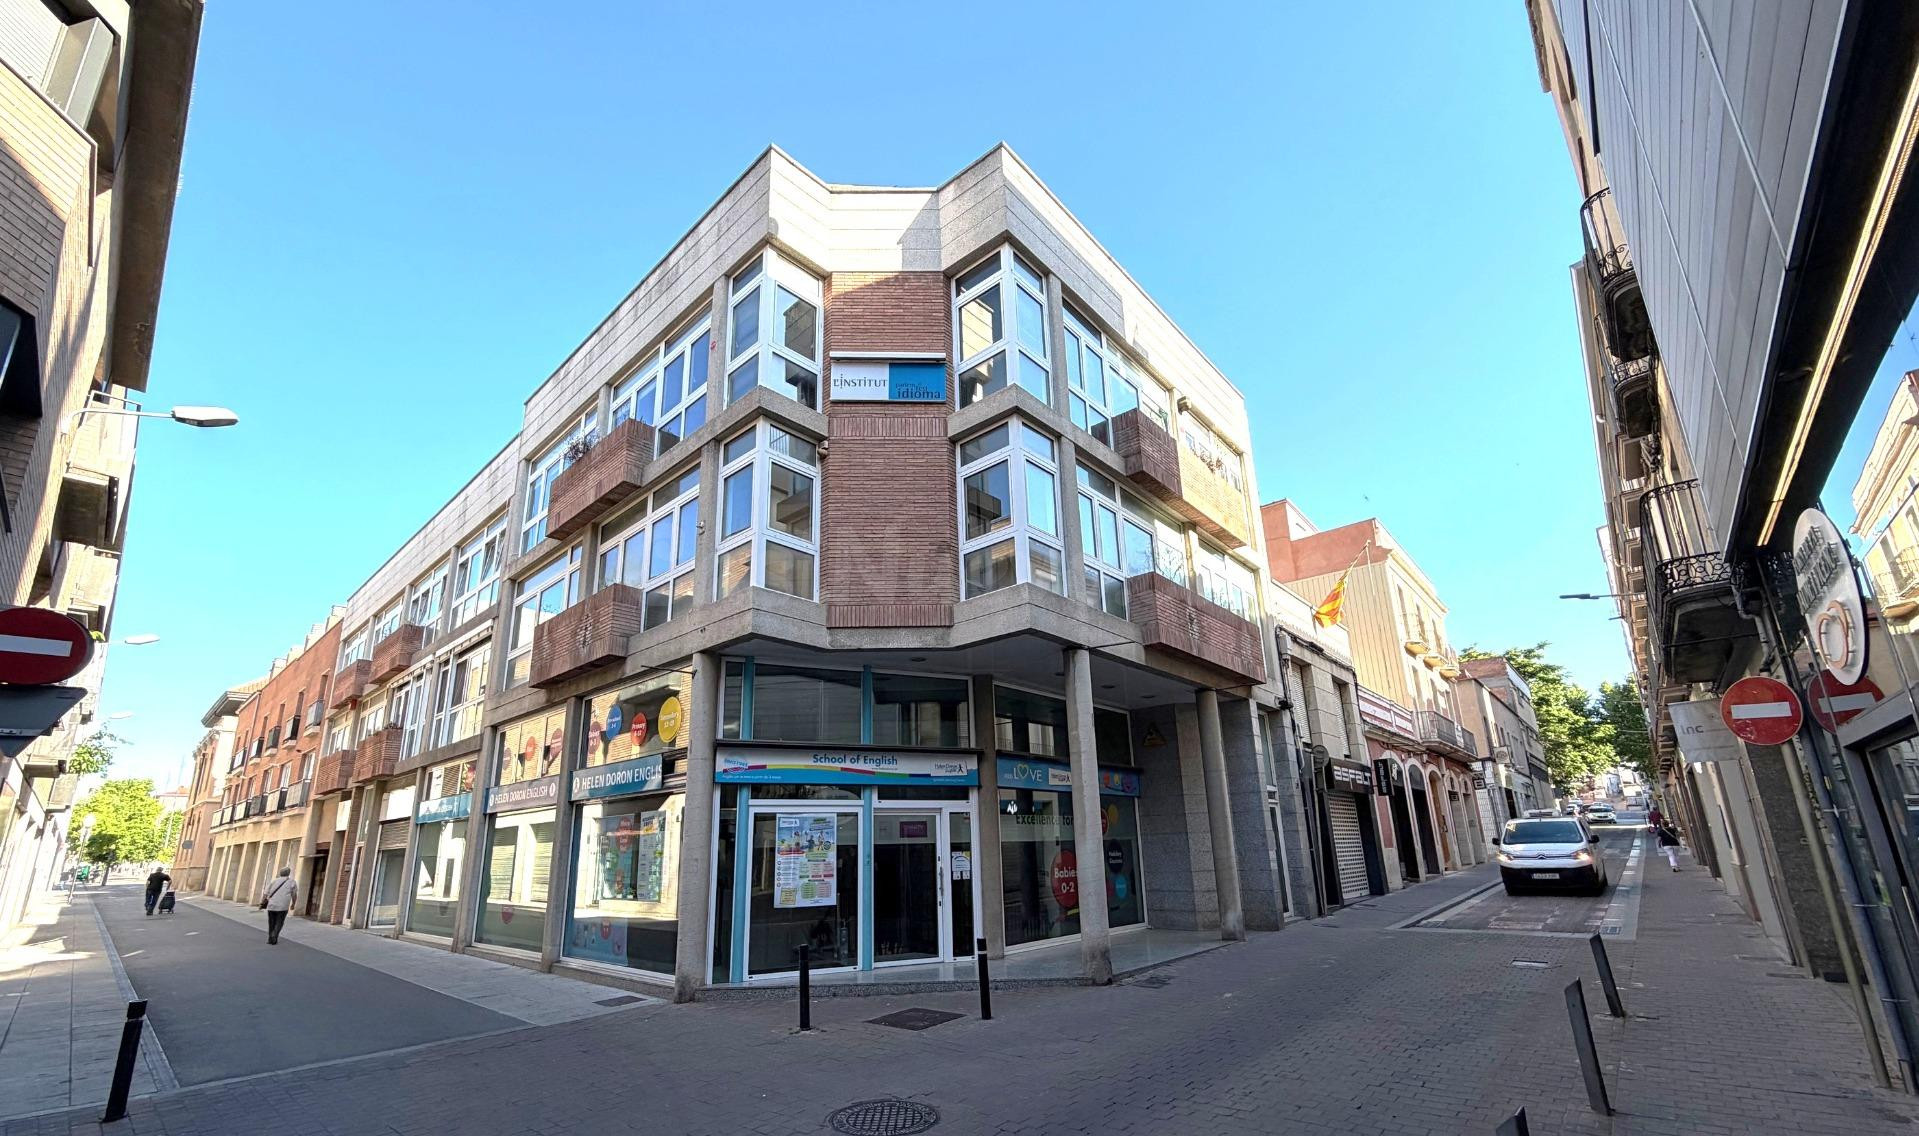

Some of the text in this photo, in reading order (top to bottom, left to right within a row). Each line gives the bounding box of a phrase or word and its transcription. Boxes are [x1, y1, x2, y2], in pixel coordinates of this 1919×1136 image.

[897, 388, 941, 399] idioma
[812, 753, 898, 767] School of English
[582, 764, 662, 790] HELEN DORON ENGLIS
[494, 792, 510, 804] HELEN
[526, 785, 548, 799] ENGLISH
